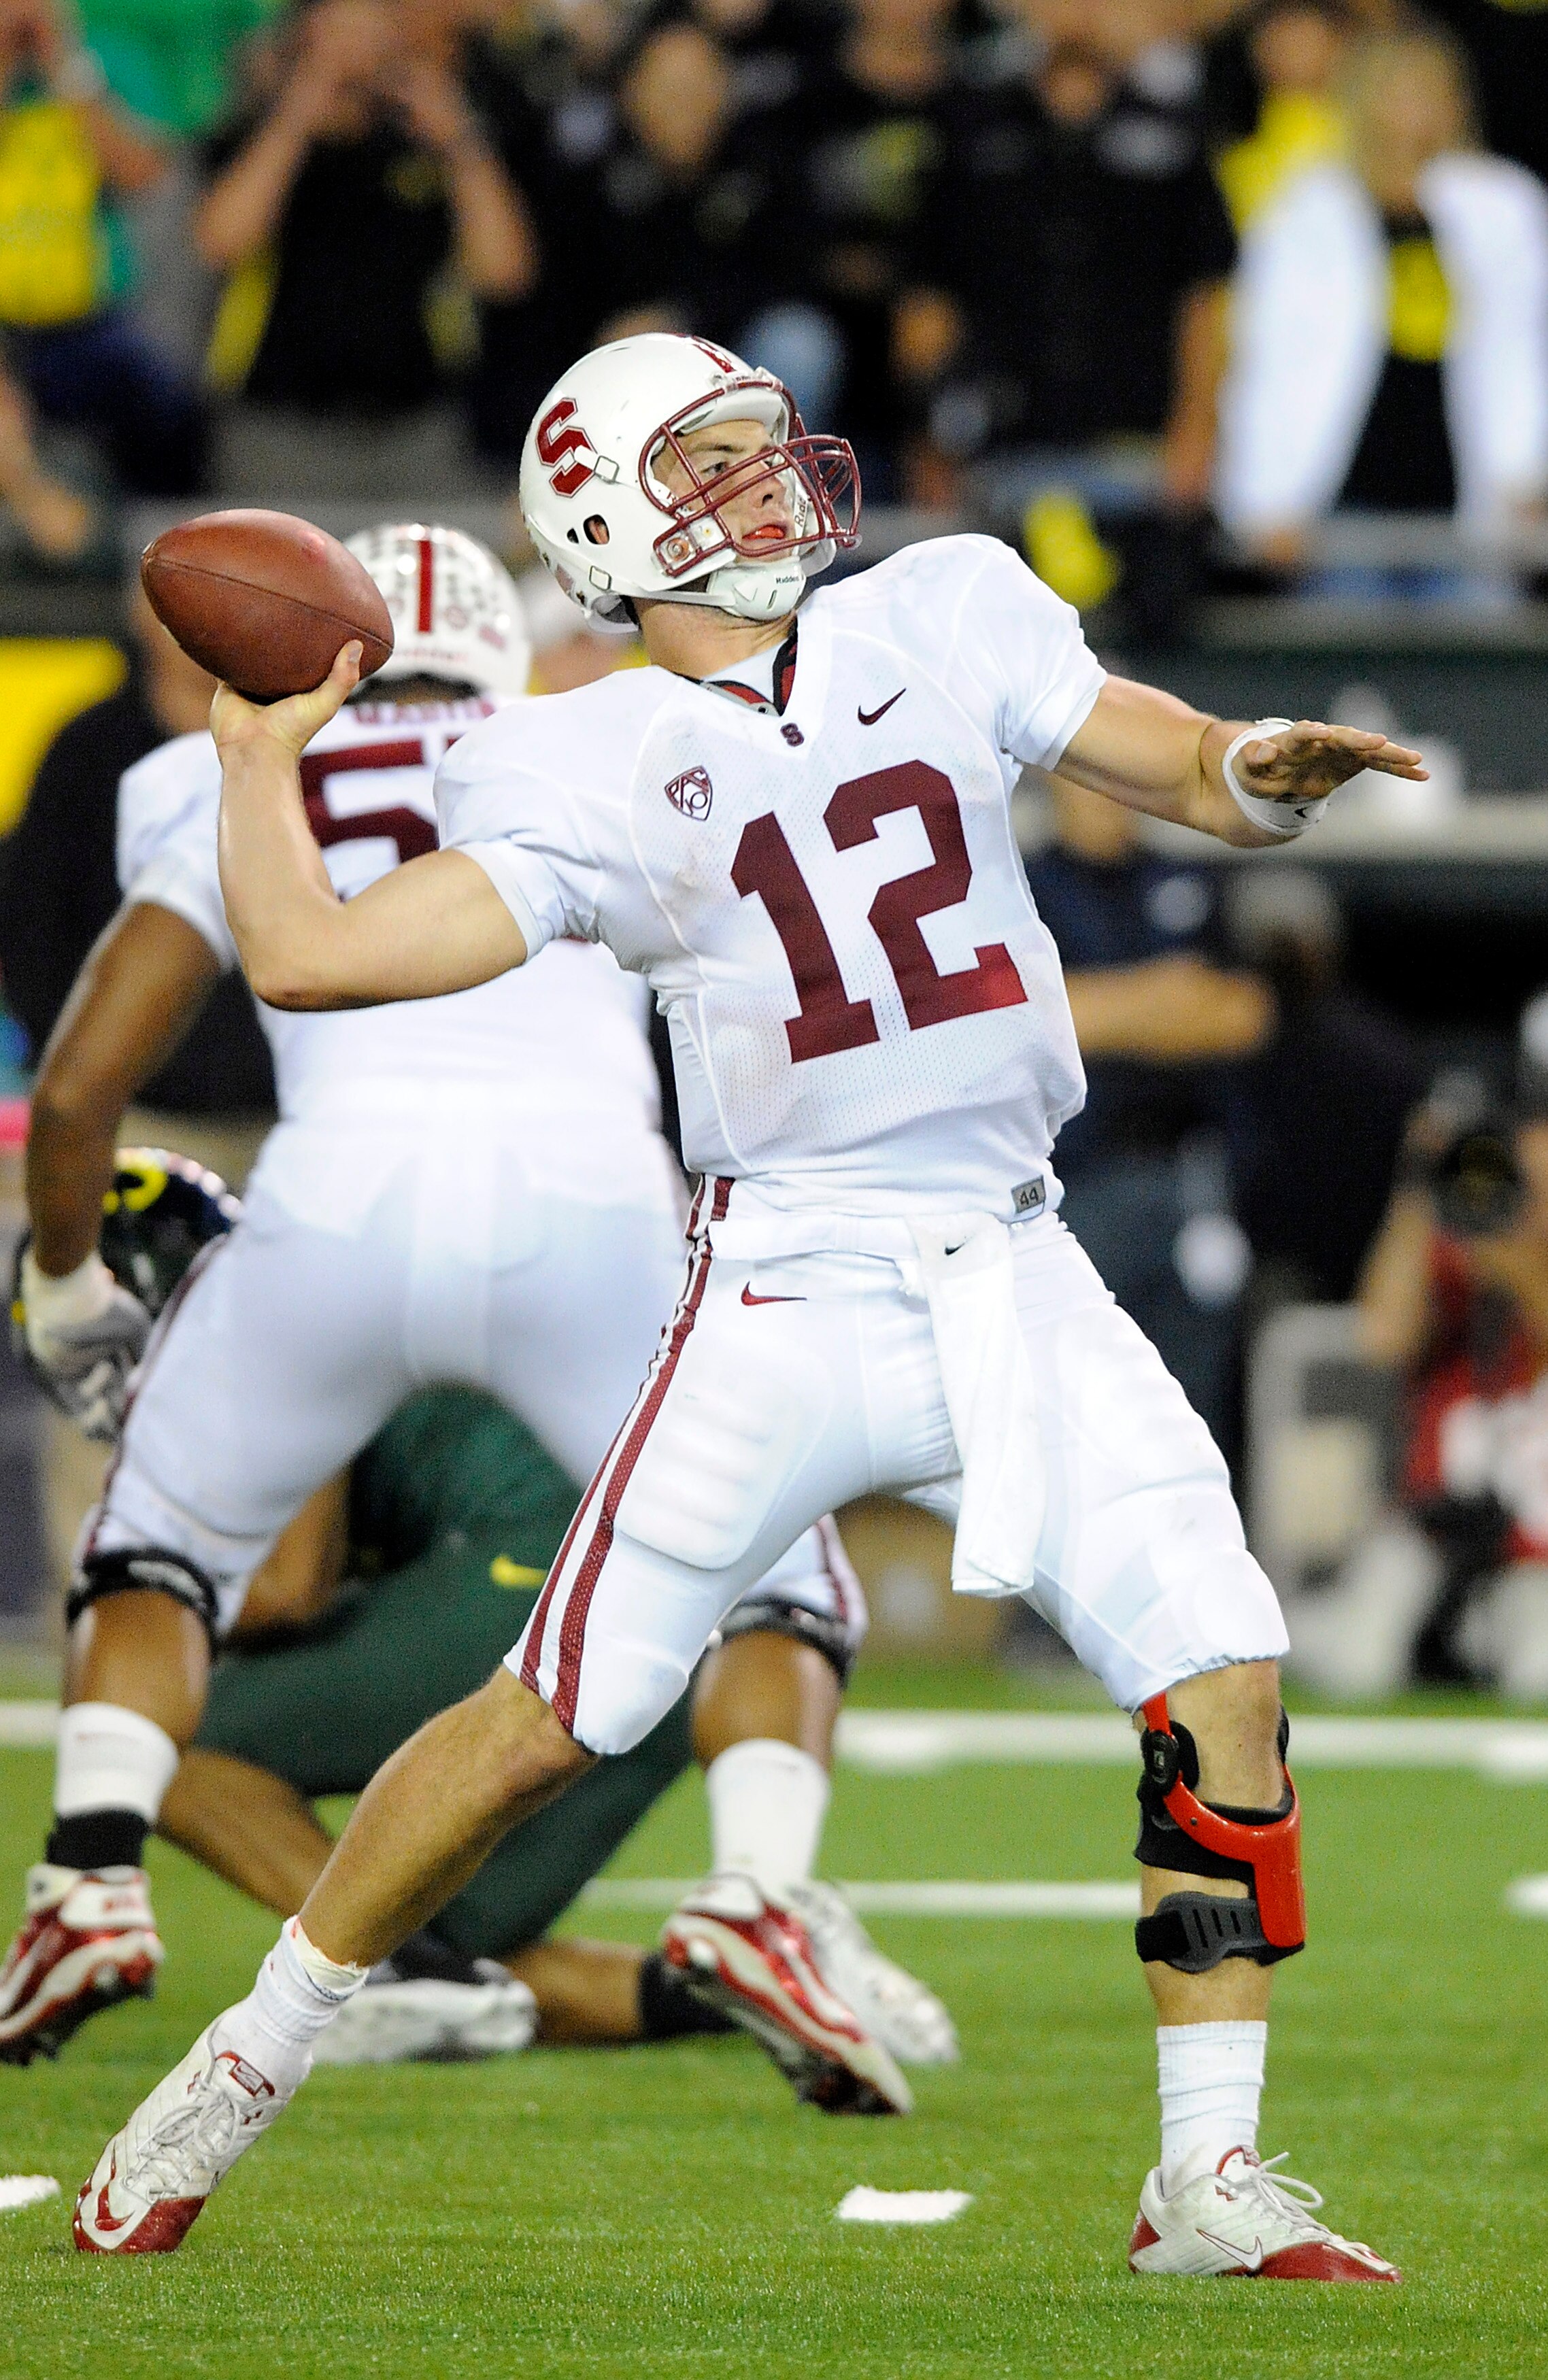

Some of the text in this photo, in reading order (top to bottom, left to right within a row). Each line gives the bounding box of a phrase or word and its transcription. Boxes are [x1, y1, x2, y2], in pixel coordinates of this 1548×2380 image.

[535, 398, 596, 498] S
[780, 722, 805, 747] S
[298, 737, 465, 874] 5
[730, 759, 1028, 1064] 12
[1020, 1187, 1039, 1205] 44
